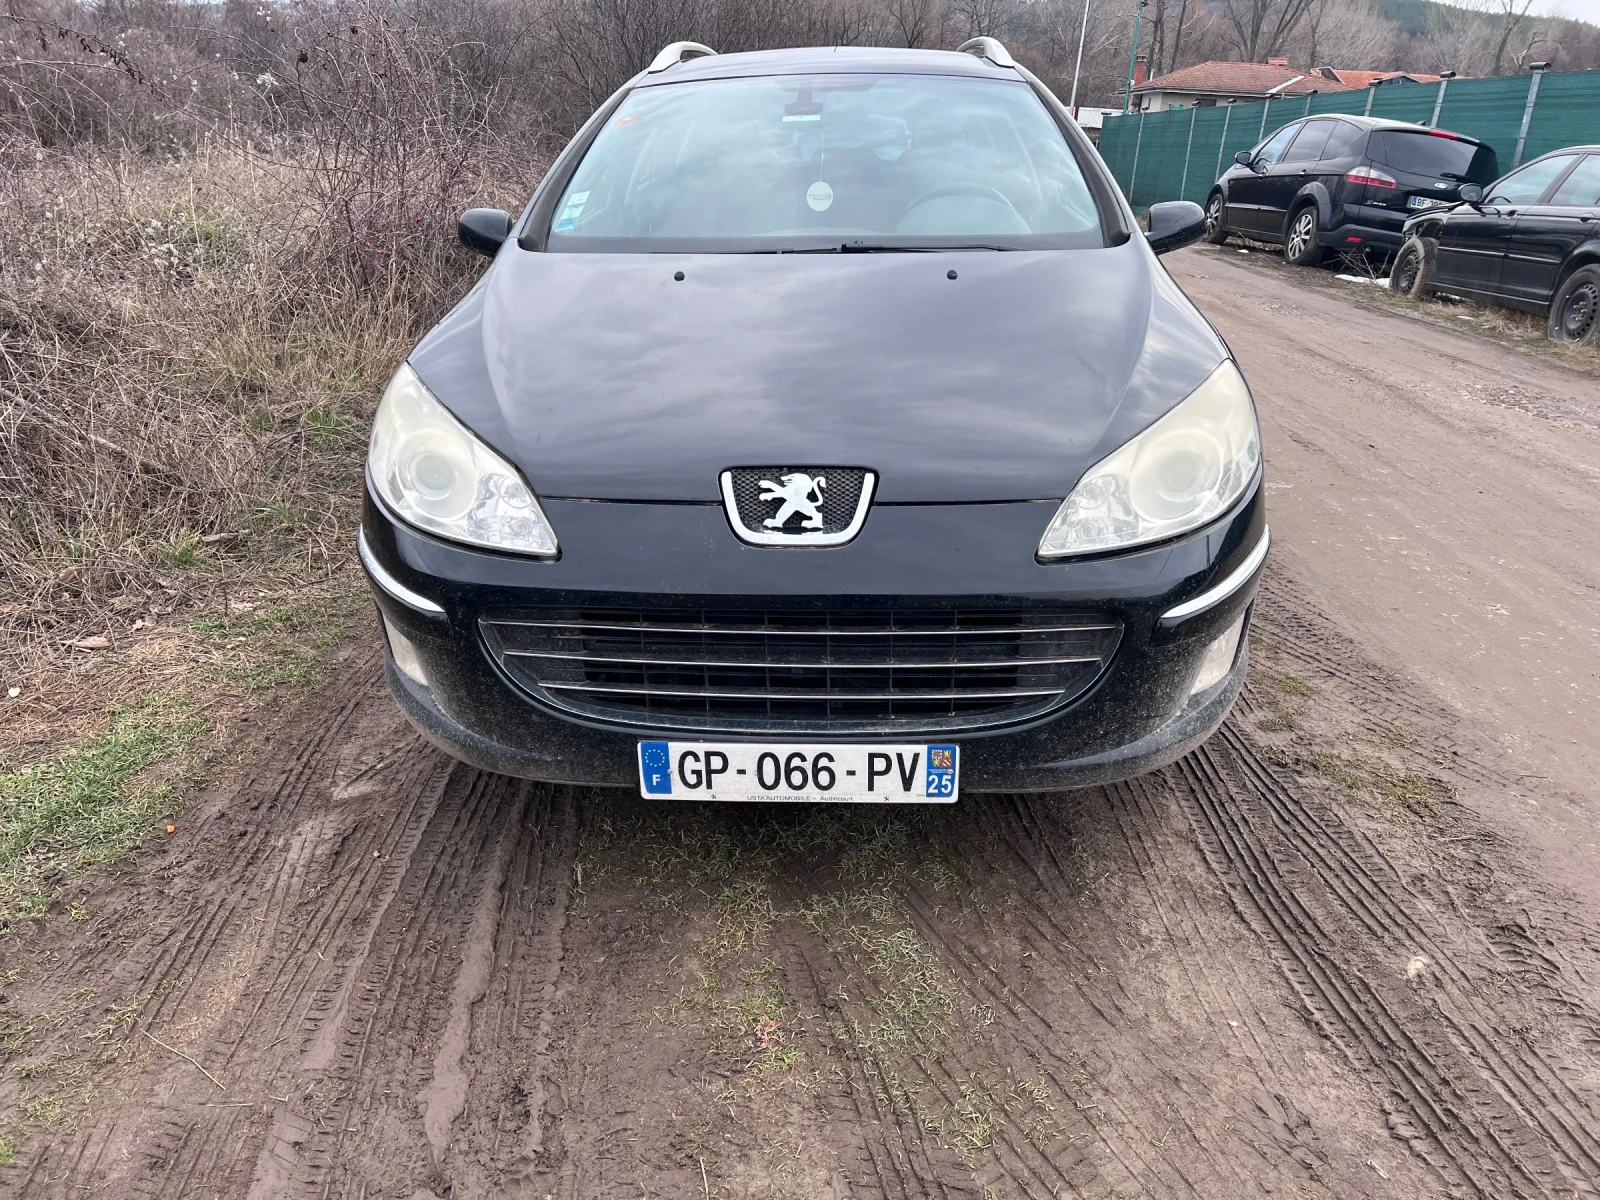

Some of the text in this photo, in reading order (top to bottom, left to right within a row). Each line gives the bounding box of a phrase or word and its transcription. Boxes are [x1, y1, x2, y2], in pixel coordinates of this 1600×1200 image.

[652, 774, 661, 786] F
[678, 750, 921, 792] GP-066-PV
[927, 774, 952, 794] 25
